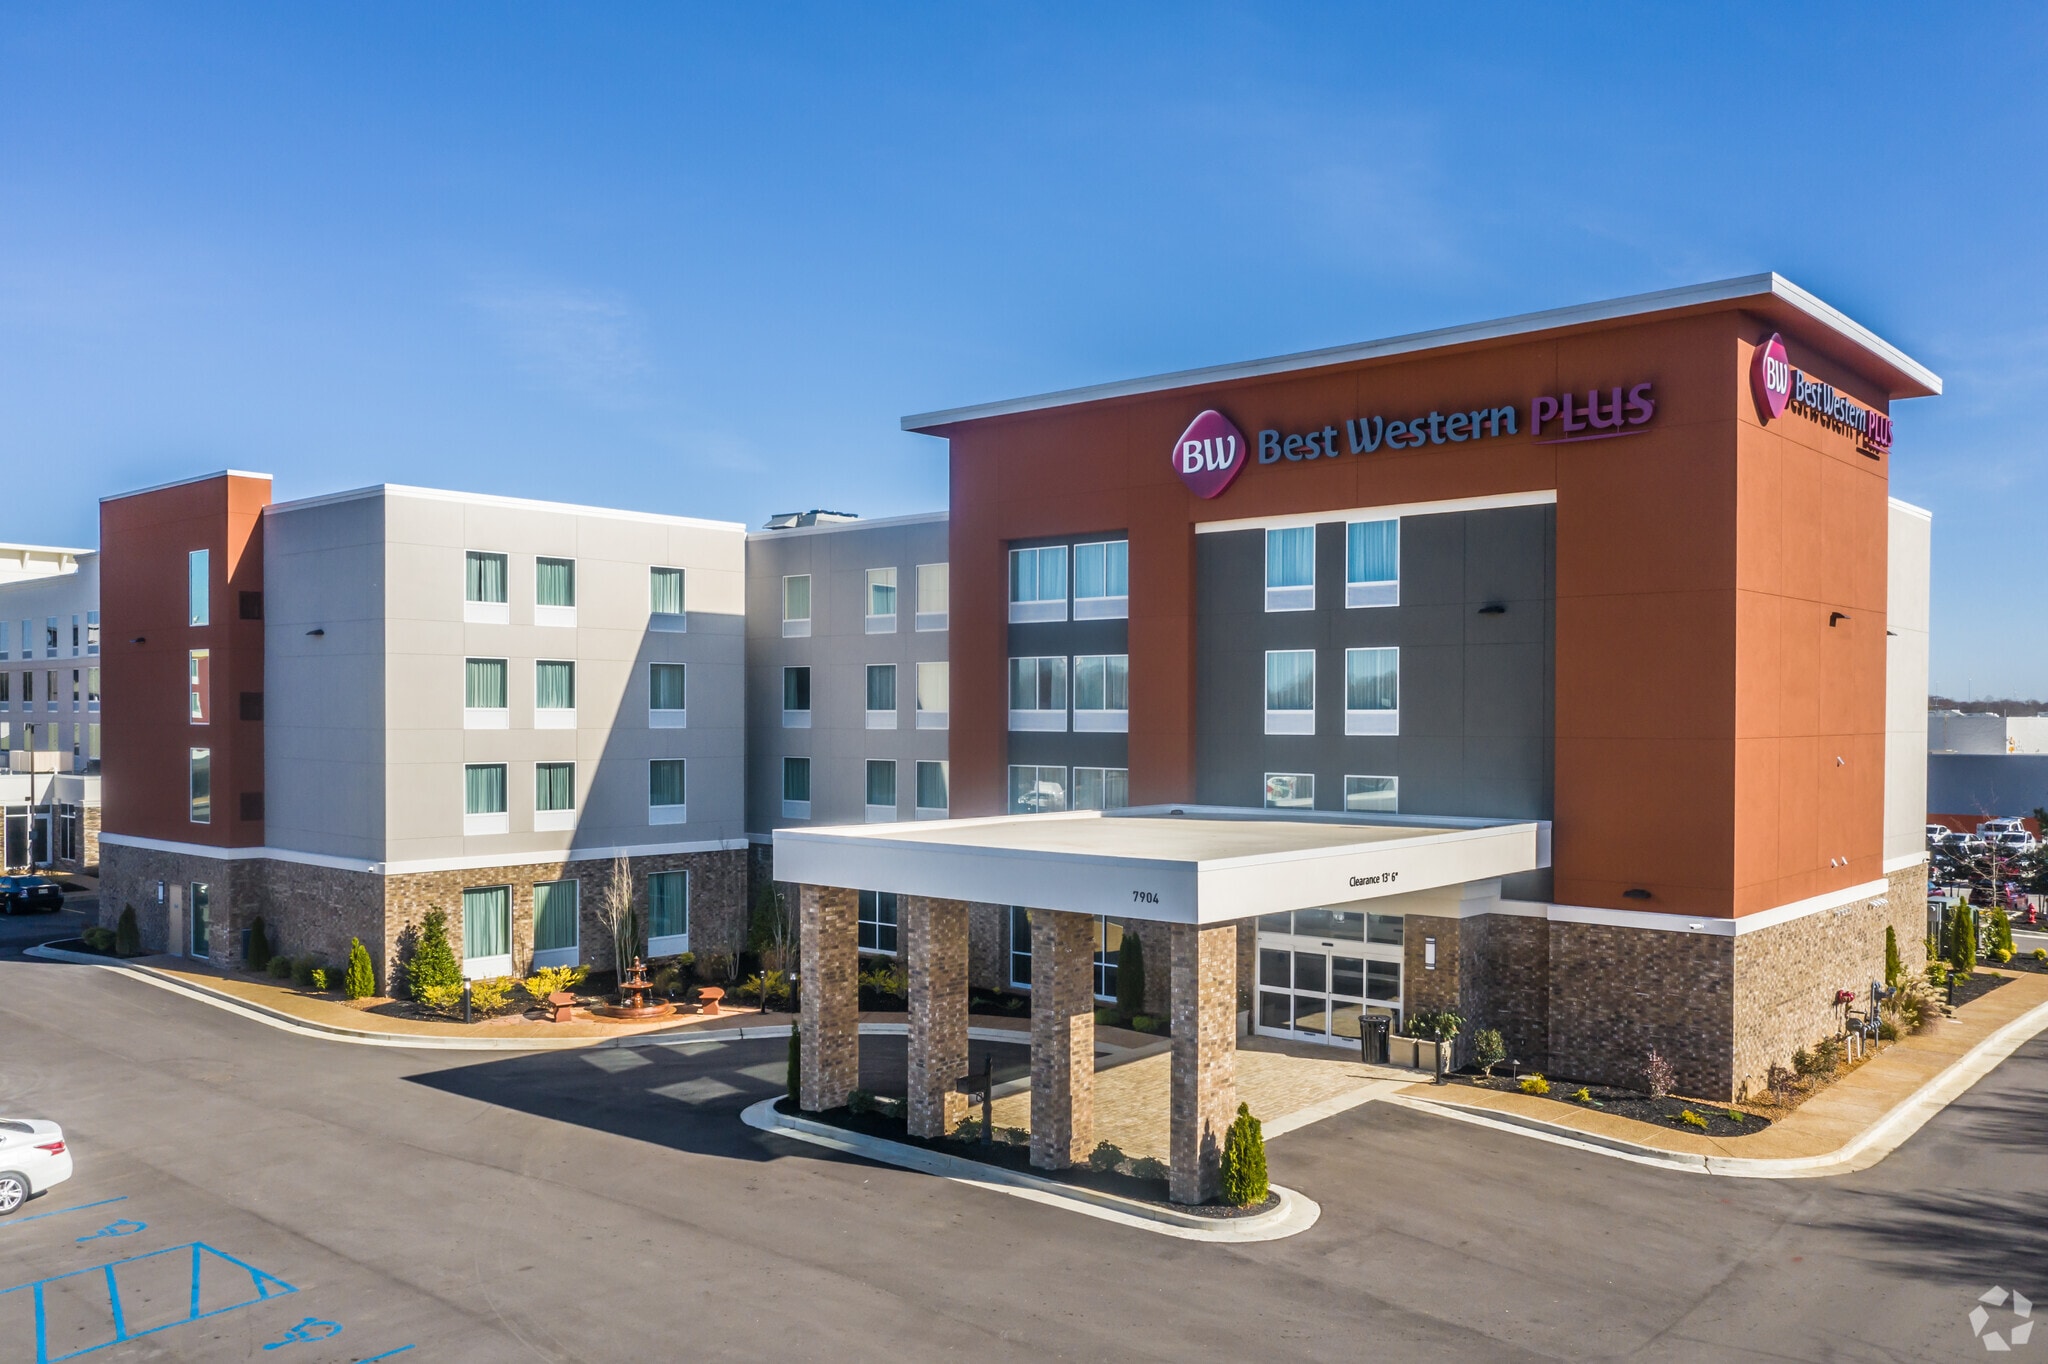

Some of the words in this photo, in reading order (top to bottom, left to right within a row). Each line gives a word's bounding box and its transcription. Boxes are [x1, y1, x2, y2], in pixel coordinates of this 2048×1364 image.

[1183, 435, 1236, 474] BW
[1259, 425, 1338, 465] Best
[1346, 405, 1518, 454] Western
[1531, 382, 1655, 436] PLUS
[1766, 356, 1788, 395] BW
[1796, 369, 1822, 410] Best
[1823, 382, 1867, 433] Western
[1868, 410, 1894, 448] PLUS
[1132, 890, 1160, 904] 7904
[1349, 876, 1381, 887] Clearance
